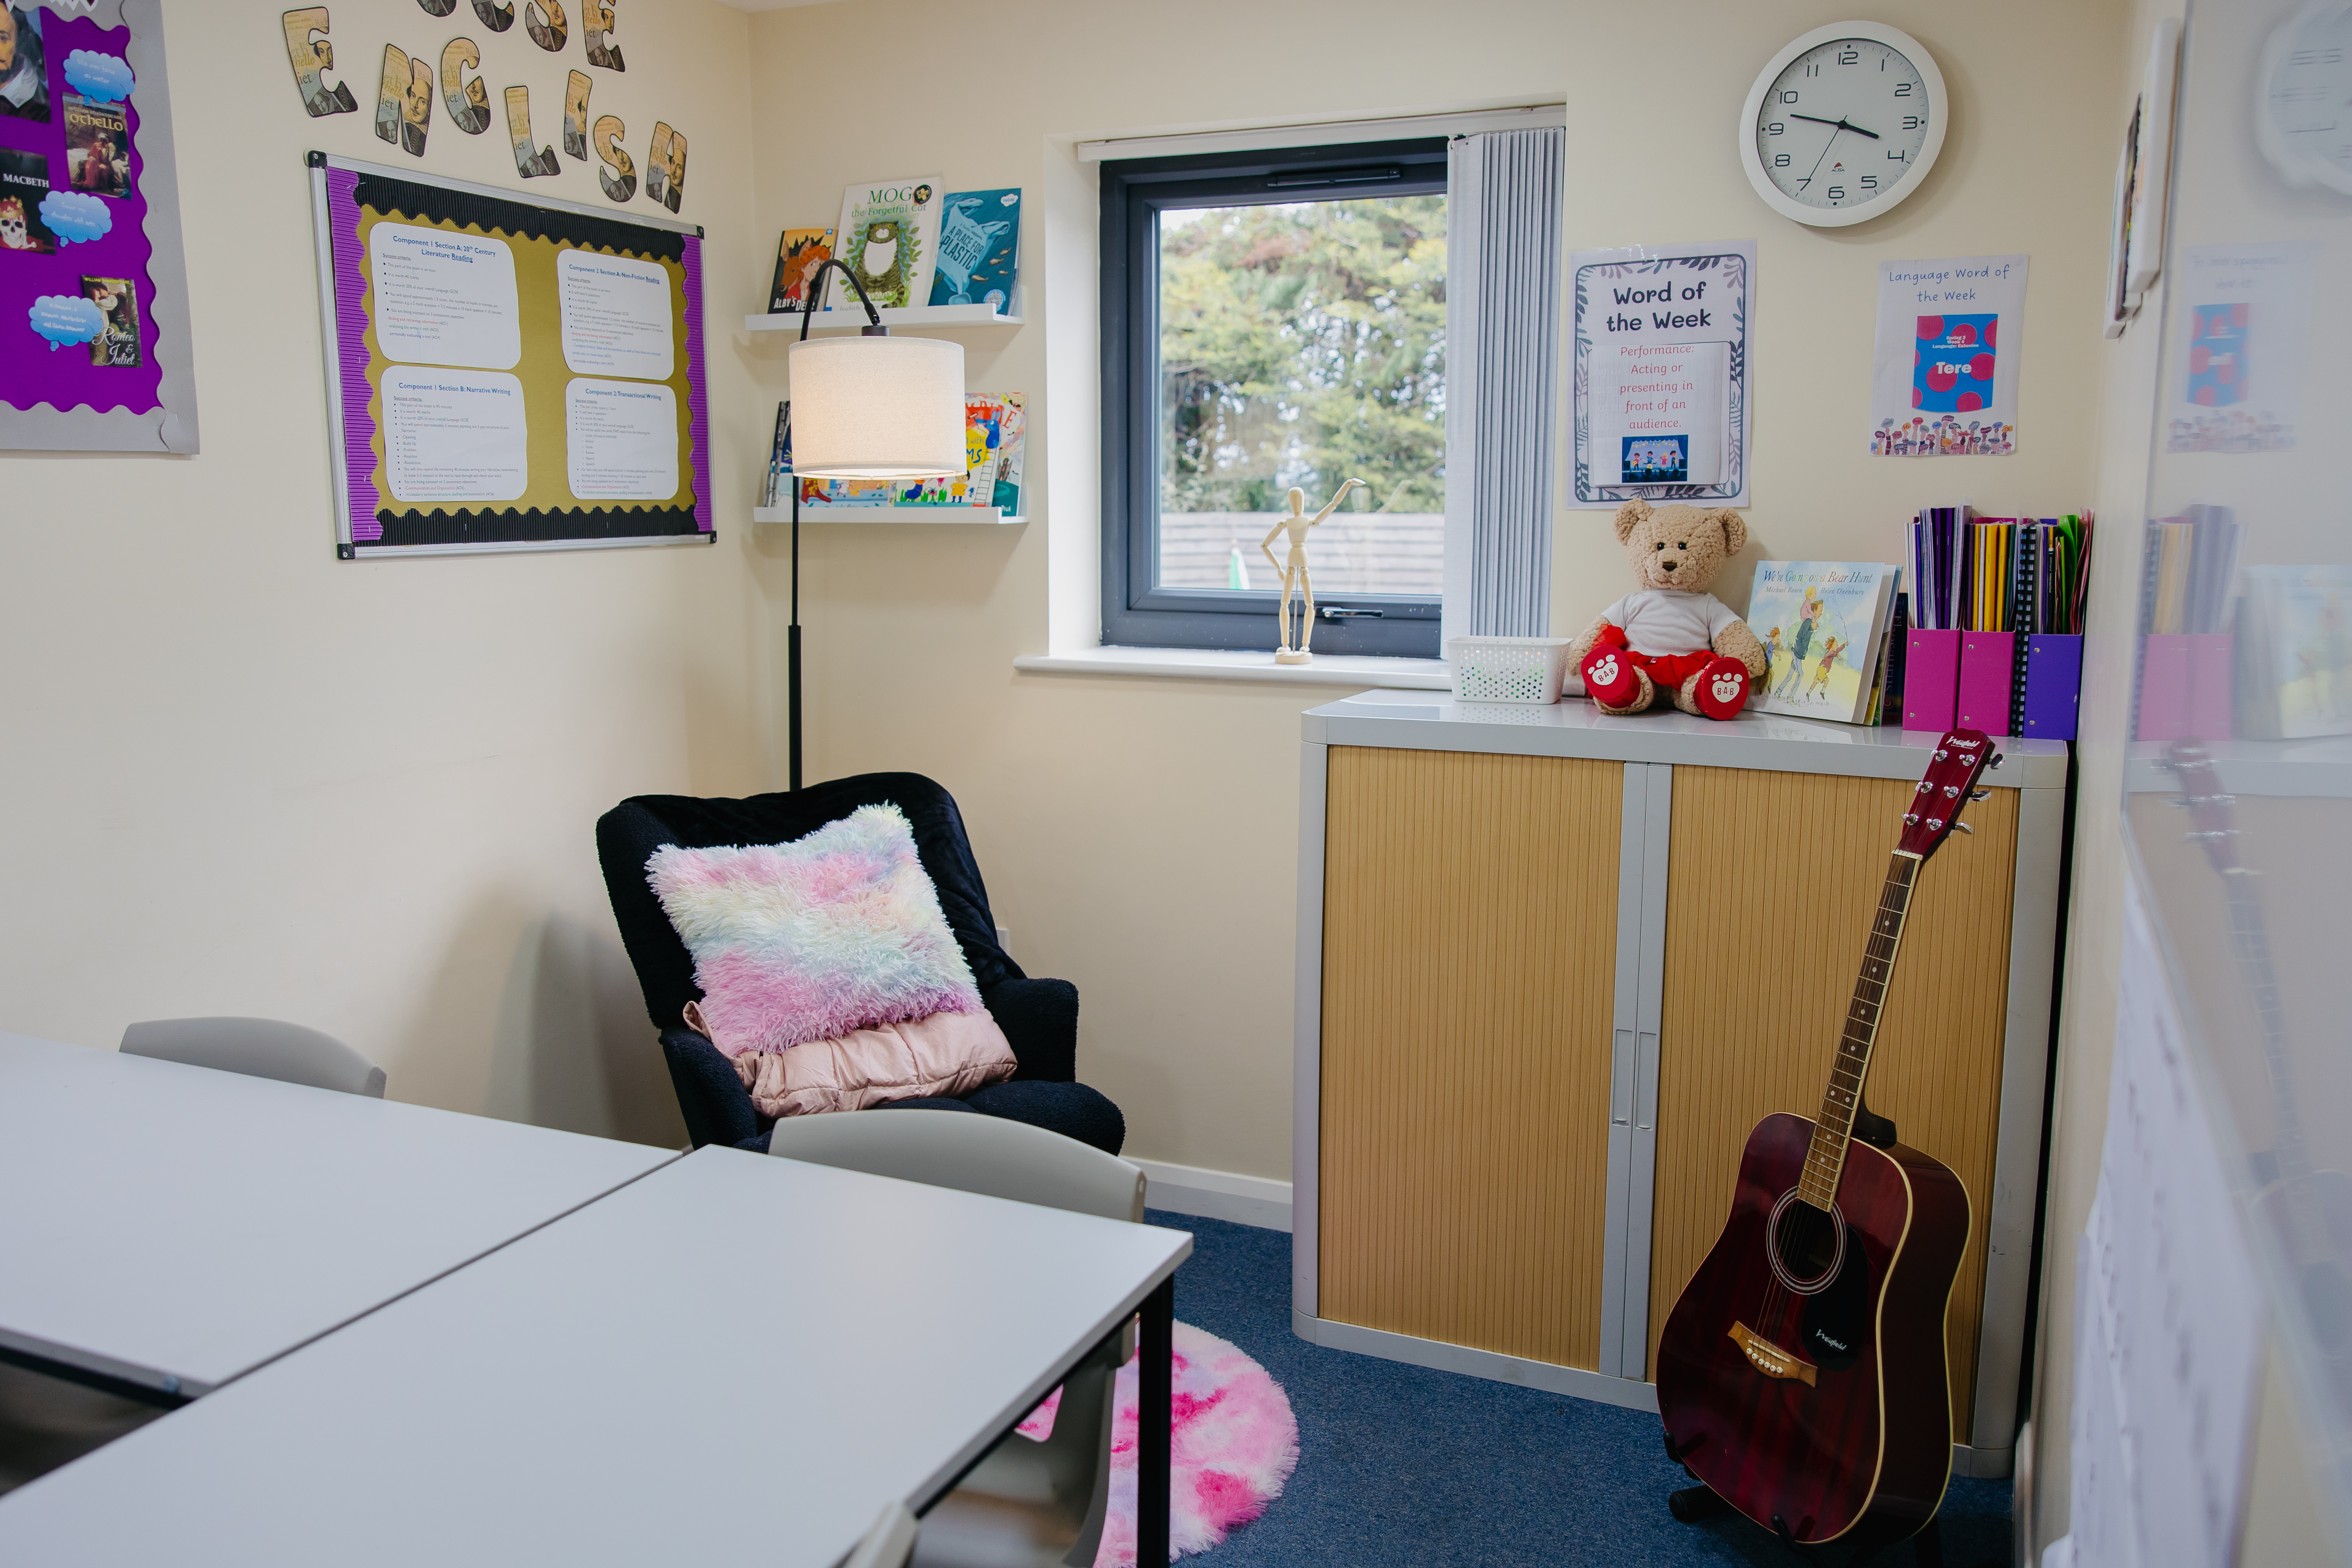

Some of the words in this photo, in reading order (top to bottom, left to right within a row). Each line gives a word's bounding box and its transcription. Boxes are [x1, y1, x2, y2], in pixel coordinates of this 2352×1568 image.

[1838, 51, 1858, 65] 12
[1806, 64, 1818, 77] 11
[1881, 59, 1884, 72] 1
[1894, 83, 1911, 97] 2
[1779, 91, 1798, 104] 10
[282, 6, 687, 214] ENGLISH
[1769, 122, 1784, 135] 9
[1902, 116, 1918, 130] 3
[1775, 154, 1790, 167] 8
[1887, 150, 1905, 163] 4
[3, 173, 50, 188] MACBETH
[1796, 179, 1812, 192] 7
[1861, 176, 1877, 189] 5
[867, 186, 912, 205] MOG
[1828, 186, 1845, 199] 6
[851, 208, 865, 218] the
[868, 204, 908, 217] Forgetful
[911, 202, 927, 212] Cat
[393, 235, 429, 246] Component
[435, 241, 455, 250] Section
[474, 247, 495, 257] Century
[948, 226, 956, 235] A
[953, 228, 973, 247] PLACE
[970, 241, 984, 255] FOR
[421, 249, 450, 258] Literature
[451, 253, 472, 263] Reading
[939, 235, 977, 270] PLASTIC
[569, 264, 595, 273] Component
[645, 276, 660, 284] Reading
[1889, 270, 1949, 285] Language
[1955, 265, 1989, 279] Word
[1995, 264, 2010, 280] of
[1613, 280, 1672, 305] Word
[1682, 281, 1707, 301] of
[1917, 290, 1938, 303] the
[1944, 288, 1976, 301] Week
[773, 295, 797, 309] ALBY'S
[1606, 312, 1642, 332] the
[1652, 309, 1711, 330] Week
[91, 325, 135, 346] Romeo
[101, 344, 135, 365] Juliet
[126, 344, 133, 354] &
[1620, 345, 1695, 358] Performance:
[1631, 364, 1667, 376] Acting
[1671, 364, 1683, 373] or
[1936, 361, 1972, 374] Tere
[1620, 382, 1678, 396] presenting
[1682, 380, 1693, 391] in
[1625, 400, 1654, 414] front
[1657, 400, 1669, 413] of
[1672, 400, 1686, 410] an
[1629, 418, 1682, 429] audience.
[970, 436, 984, 444] with
[1764, 570, 1783, 582] We're
[1786, 570, 1807, 586] Going
[1820, 574, 1825, 582] a
[1828, 571, 1848, 582] Bear
[1849, 571, 1873, 583] Hunt
[1837, 588, 1864, 598] Oxenbury
[1946, 736, 1981, 747] Westfield
[1815, 1328, 1847, 1350] Westfield
